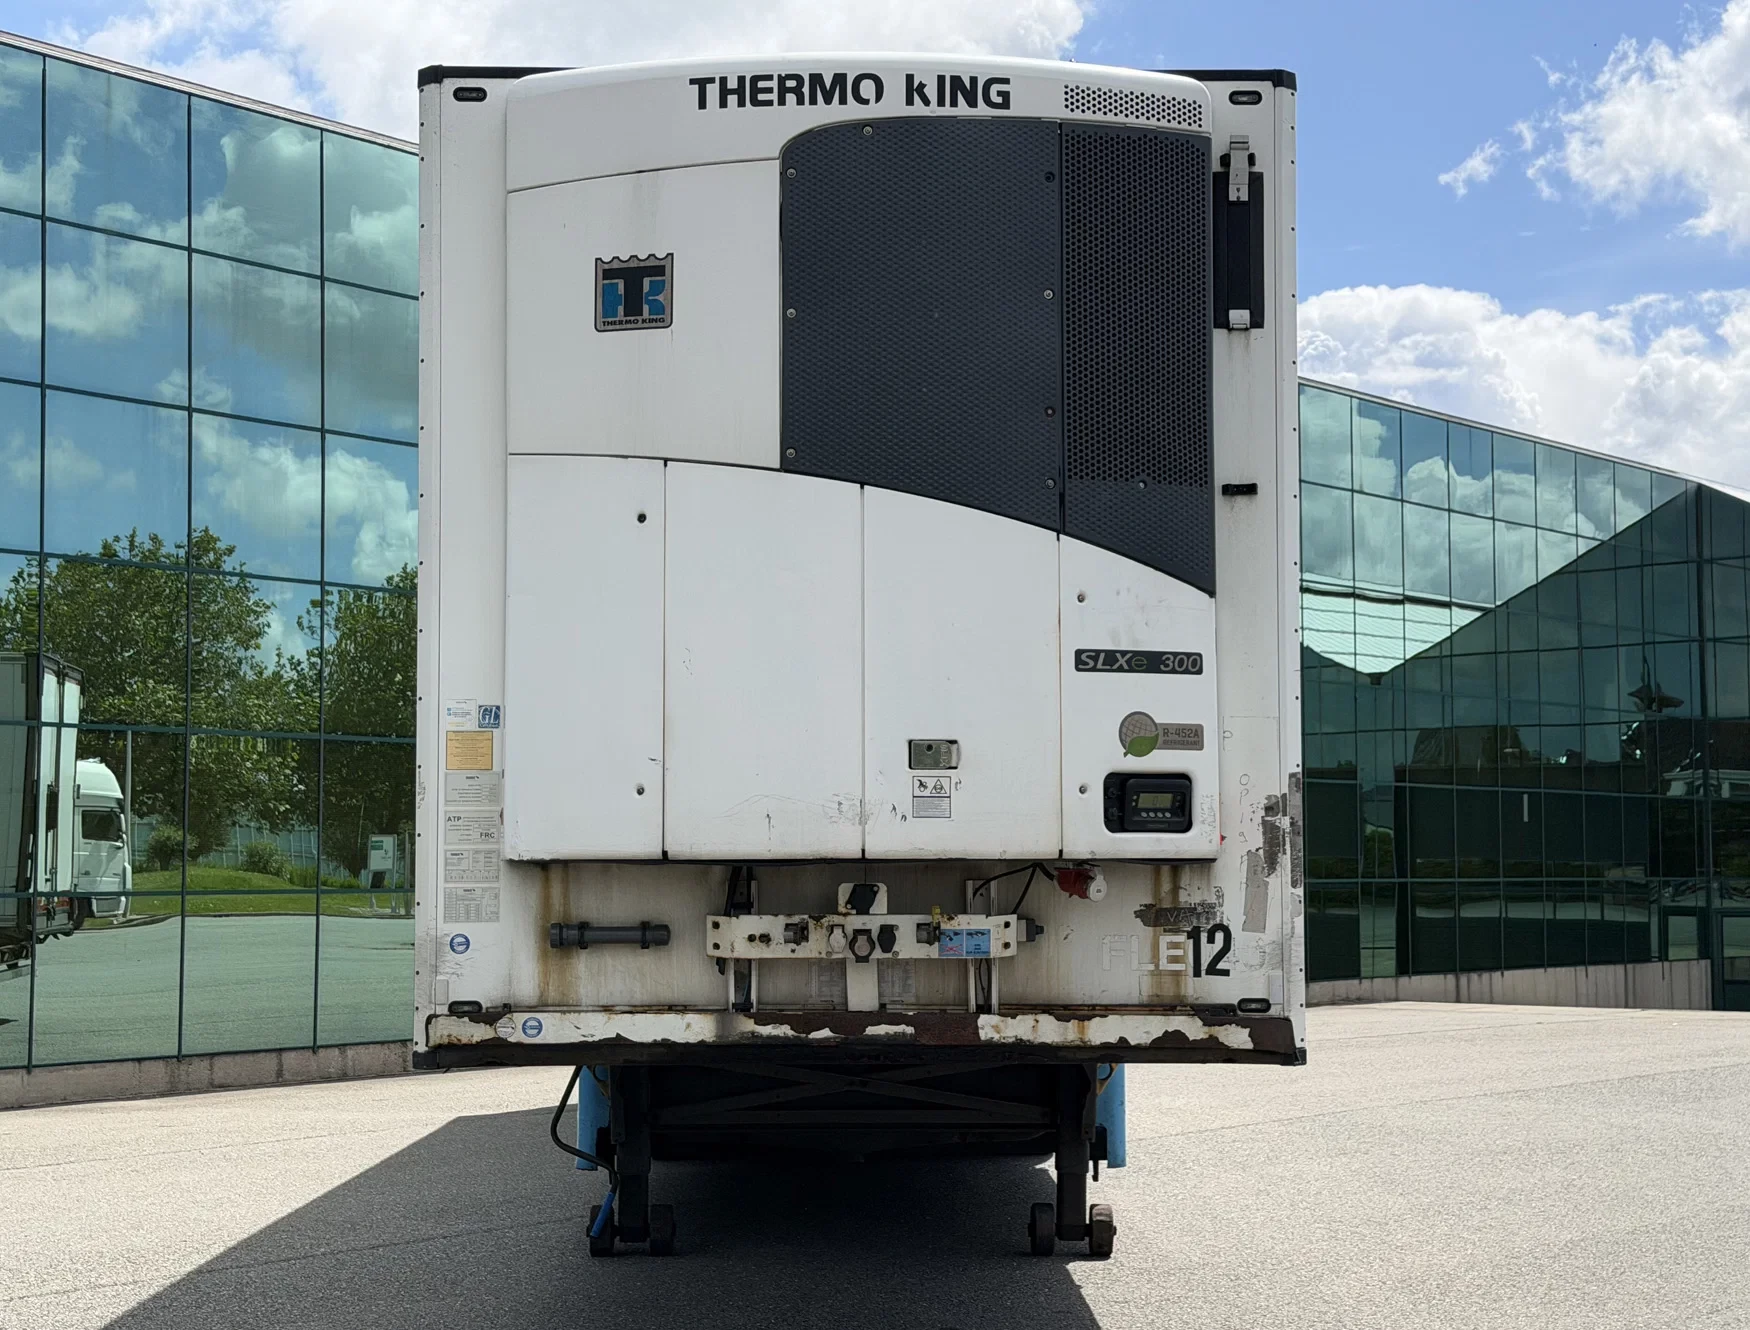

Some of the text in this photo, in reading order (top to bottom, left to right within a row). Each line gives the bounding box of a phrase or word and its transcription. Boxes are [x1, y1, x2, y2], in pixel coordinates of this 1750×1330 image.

[689, 73, 885, 111] THERMO
[602, 317, 666, 327] THERMO KING
[1160, 654, 1201, 672] 300
[1162, 727, 1200, 739] R-452A
[480, 831, 496, 839] FRC
